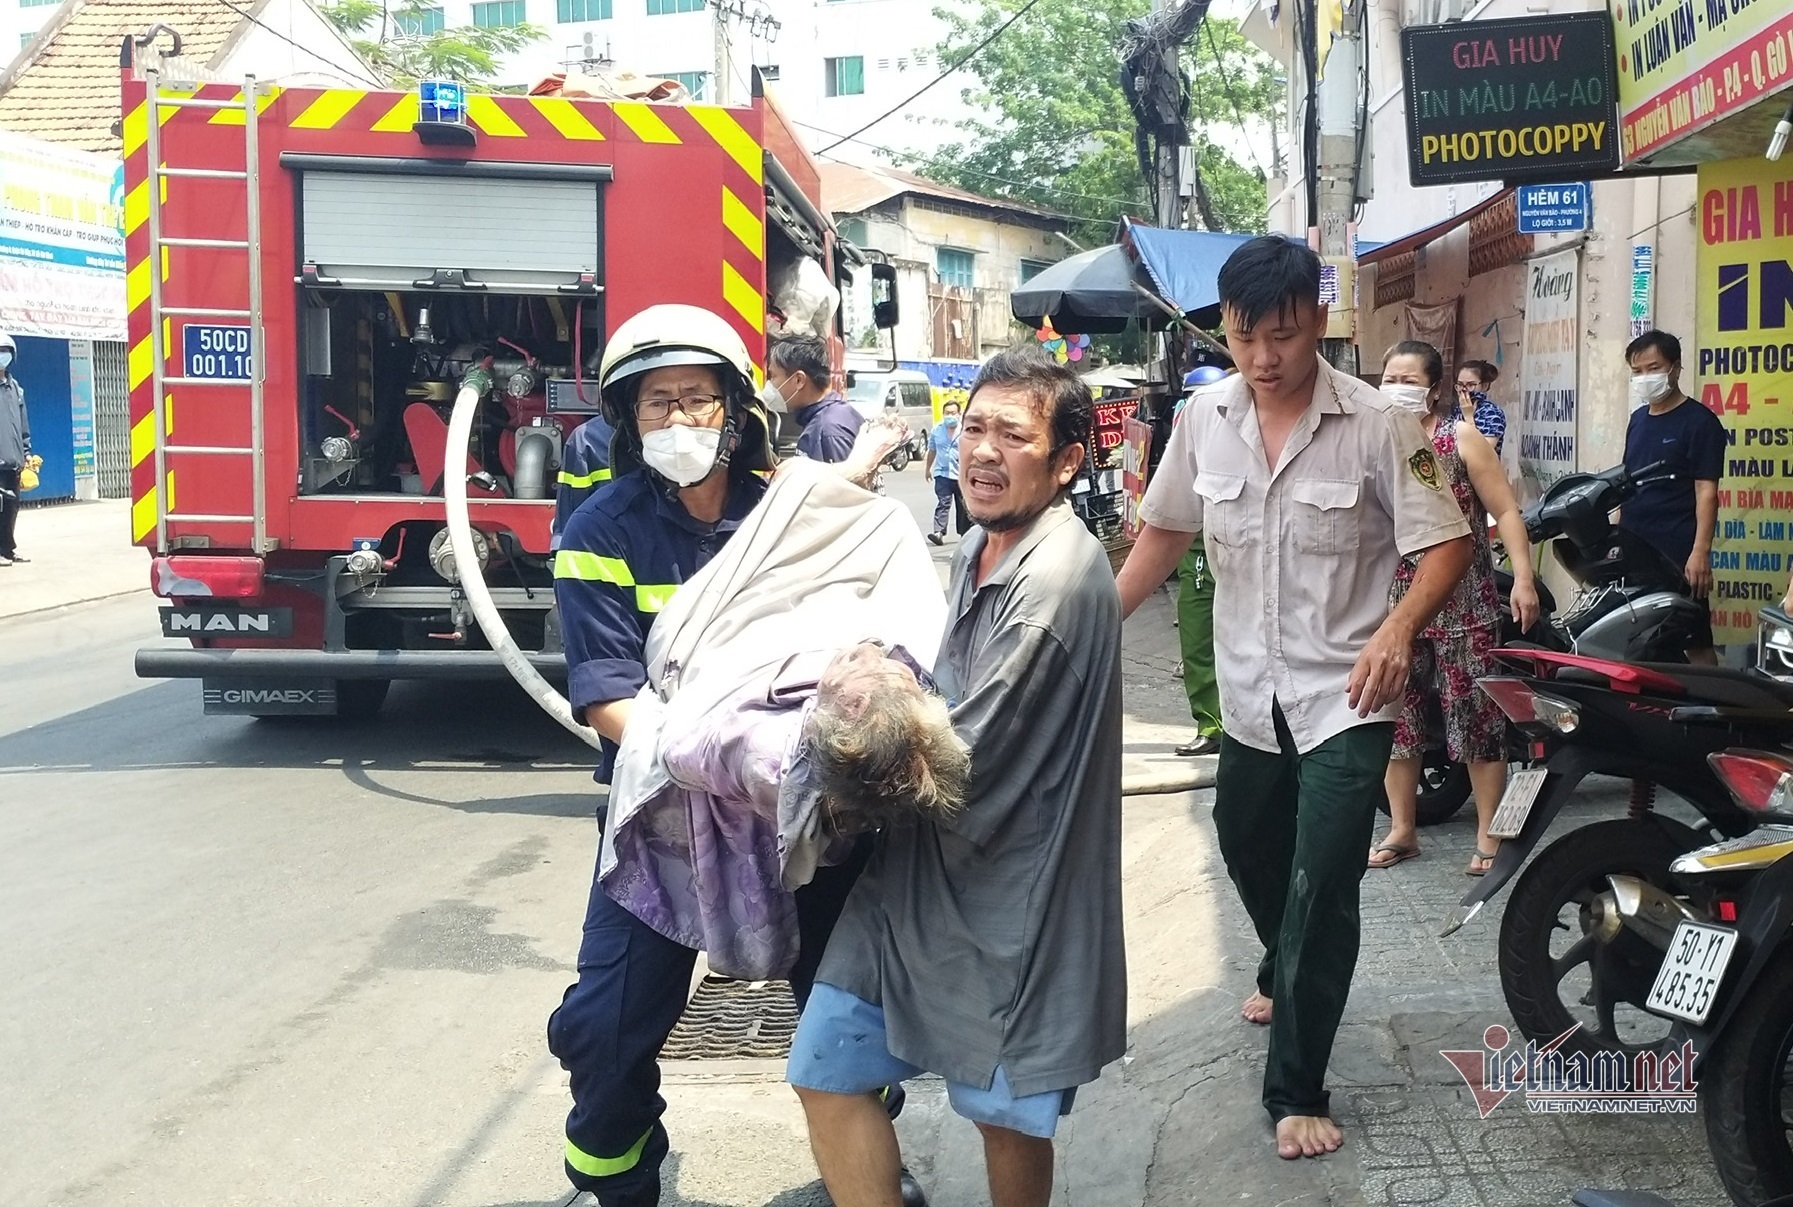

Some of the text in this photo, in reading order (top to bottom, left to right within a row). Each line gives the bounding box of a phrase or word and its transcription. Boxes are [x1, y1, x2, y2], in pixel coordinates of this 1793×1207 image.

[1453, 34, 1563, 69] GIA HUY
[1631, 38, 1643, 82] IN
[1644, 17, 1671, 73] LUẬN
[1669, 88, 1692, 131] VĂN
[1766, 31, 1787, 80] GÒ
[1421, 90, 1449, 118] IN
[1459, 79, 1515, 115] MÀU
[1422, 122, 1605, 164] PHOTOCOPPY
[1562, 190, 1577, 204] 61
[1703, 185, 1762, 246] GIA
[200, 329, 248, 352] 50CD
[1702, 383, 1750, 415] A4
[1543, 430, 1573, 461] THÁNH
[1729, 457, 1774, 477] MÀU
[1758, 519, 1784, 540] LÀM
[1717, 580, 1772, 600] PLASTIC
[171, 613, 269, 631] MAN
[223, 690, 315, 703] GIMAEX
[1655, 968, 1715, 1015] 485.35
